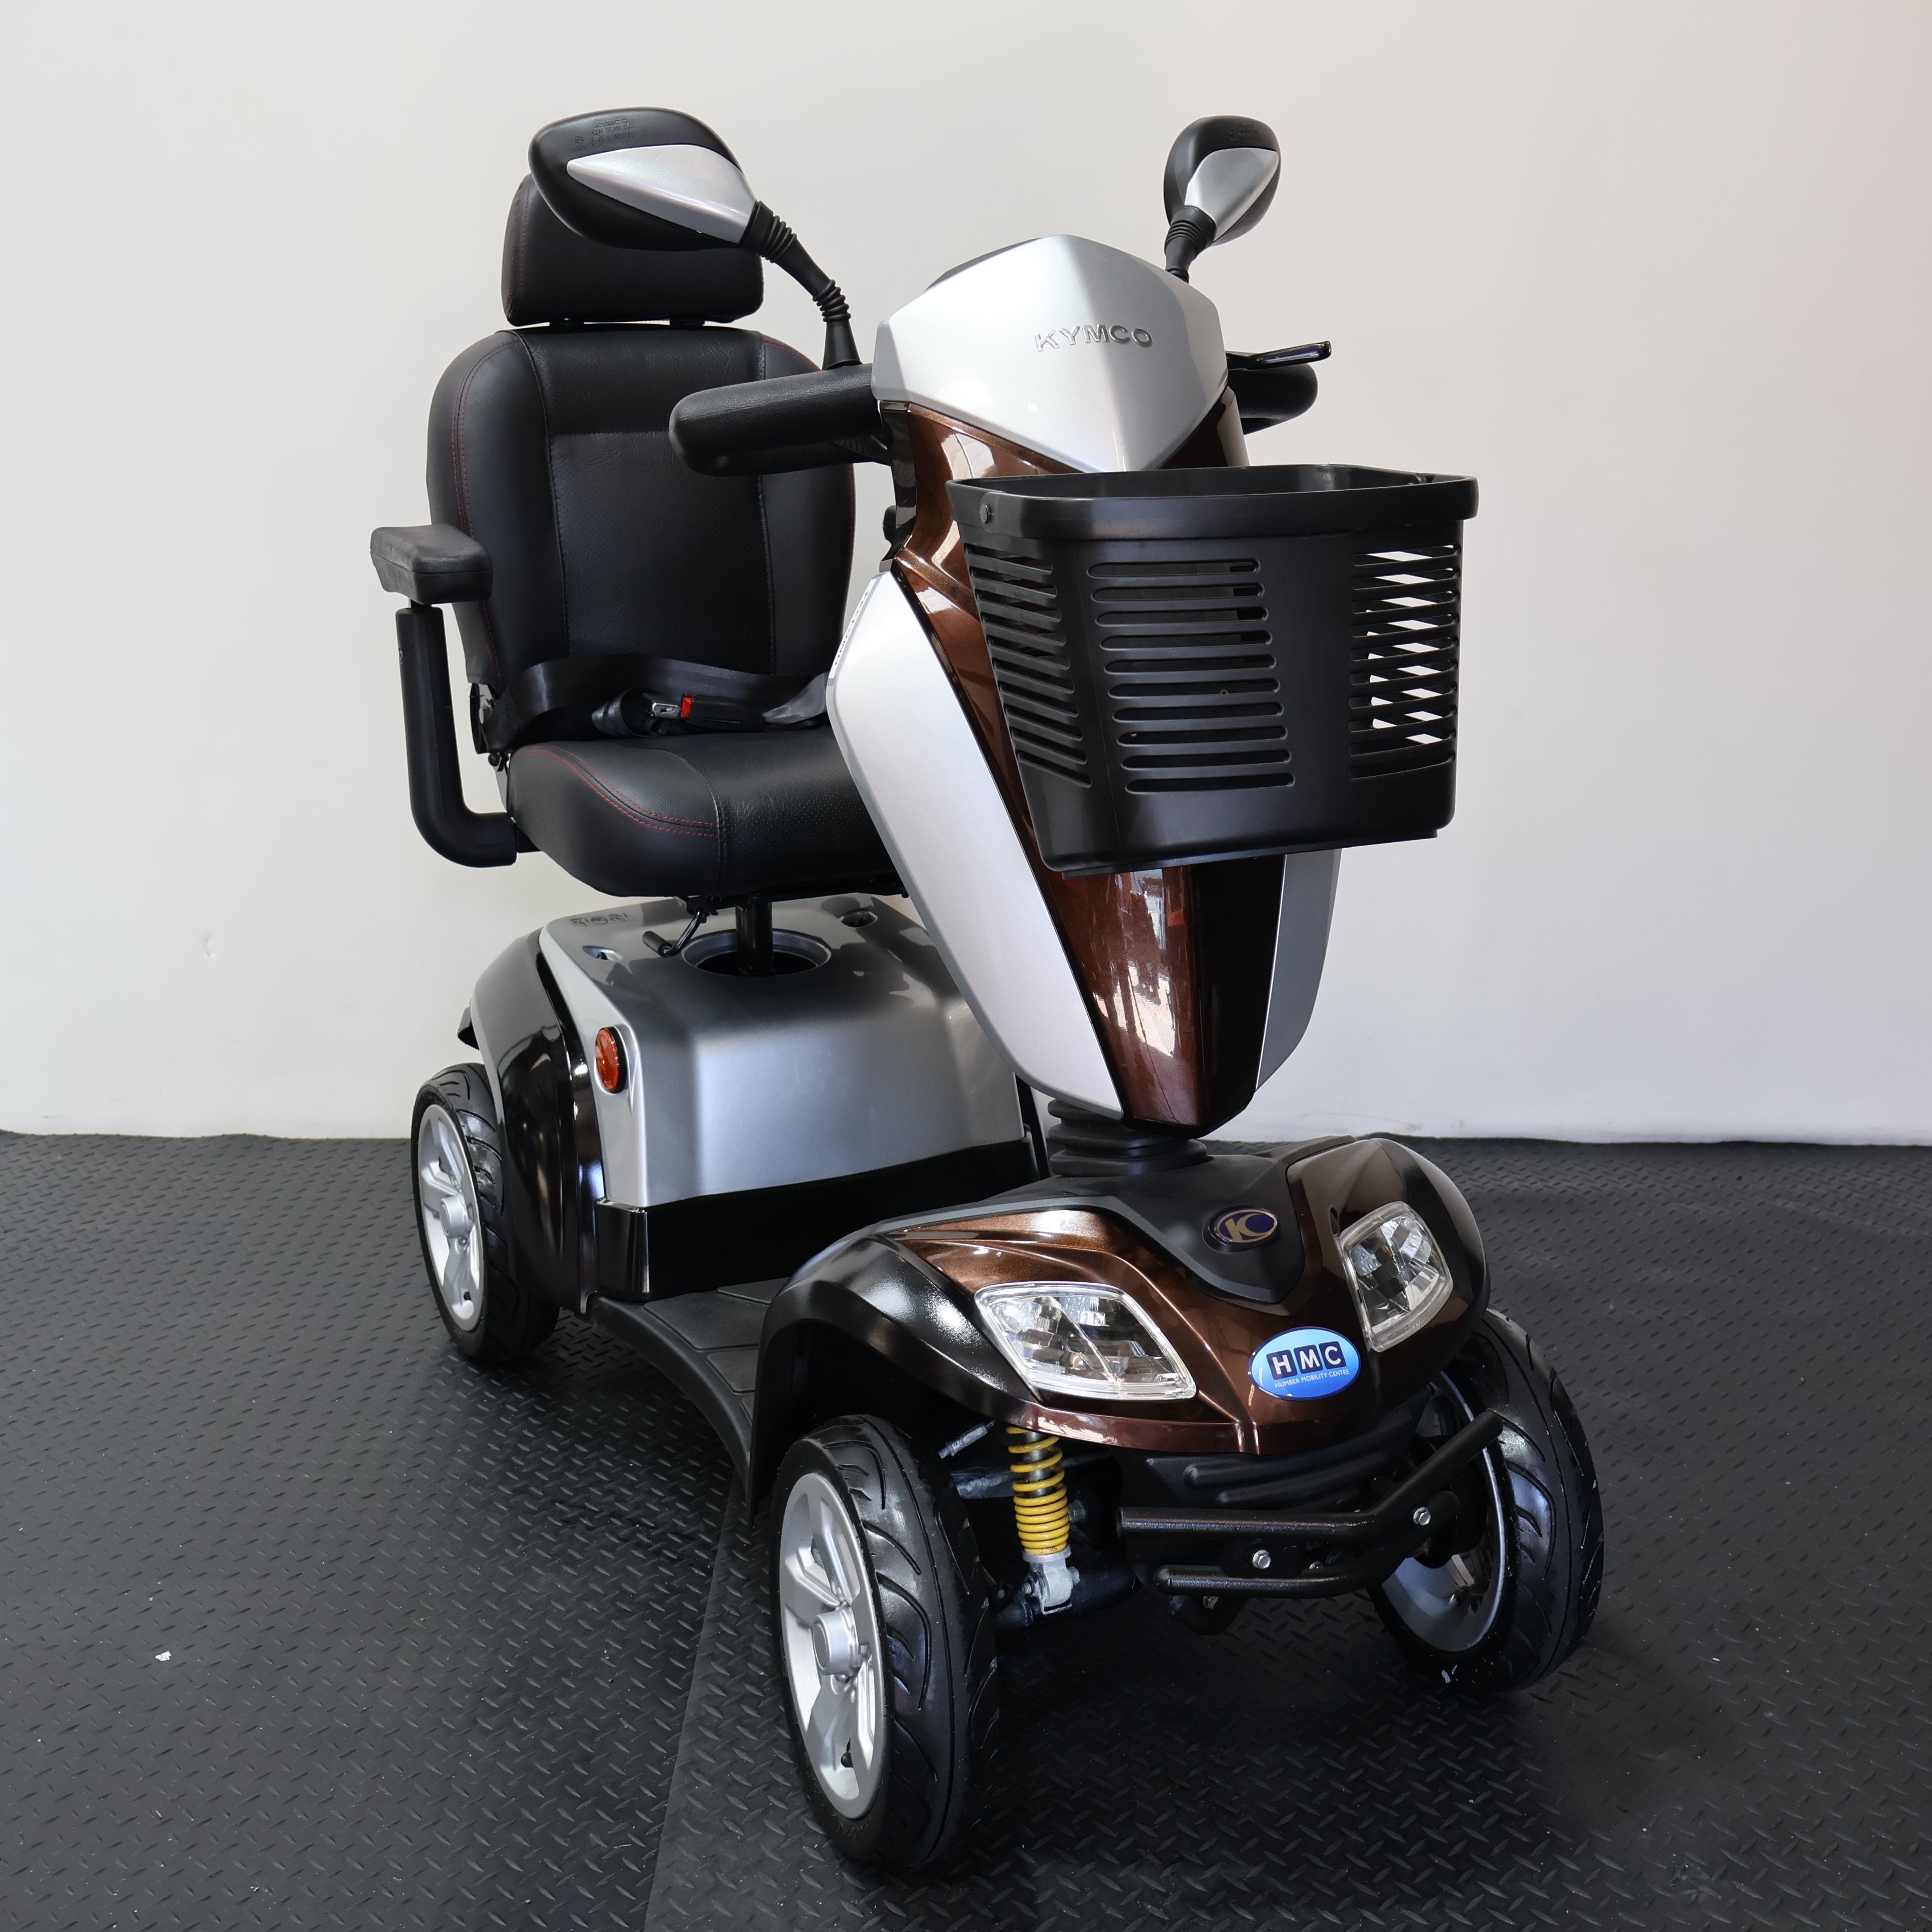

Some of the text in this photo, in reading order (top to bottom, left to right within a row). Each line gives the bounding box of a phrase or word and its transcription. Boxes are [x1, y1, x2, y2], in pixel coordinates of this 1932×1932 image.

[1034, 324, 1153, 352] KYMCO
[1272, 1346, 1341, 1375] HMC
[1274, 1369, 1350, 1389] HUMBER MOBILITY CENTRE
